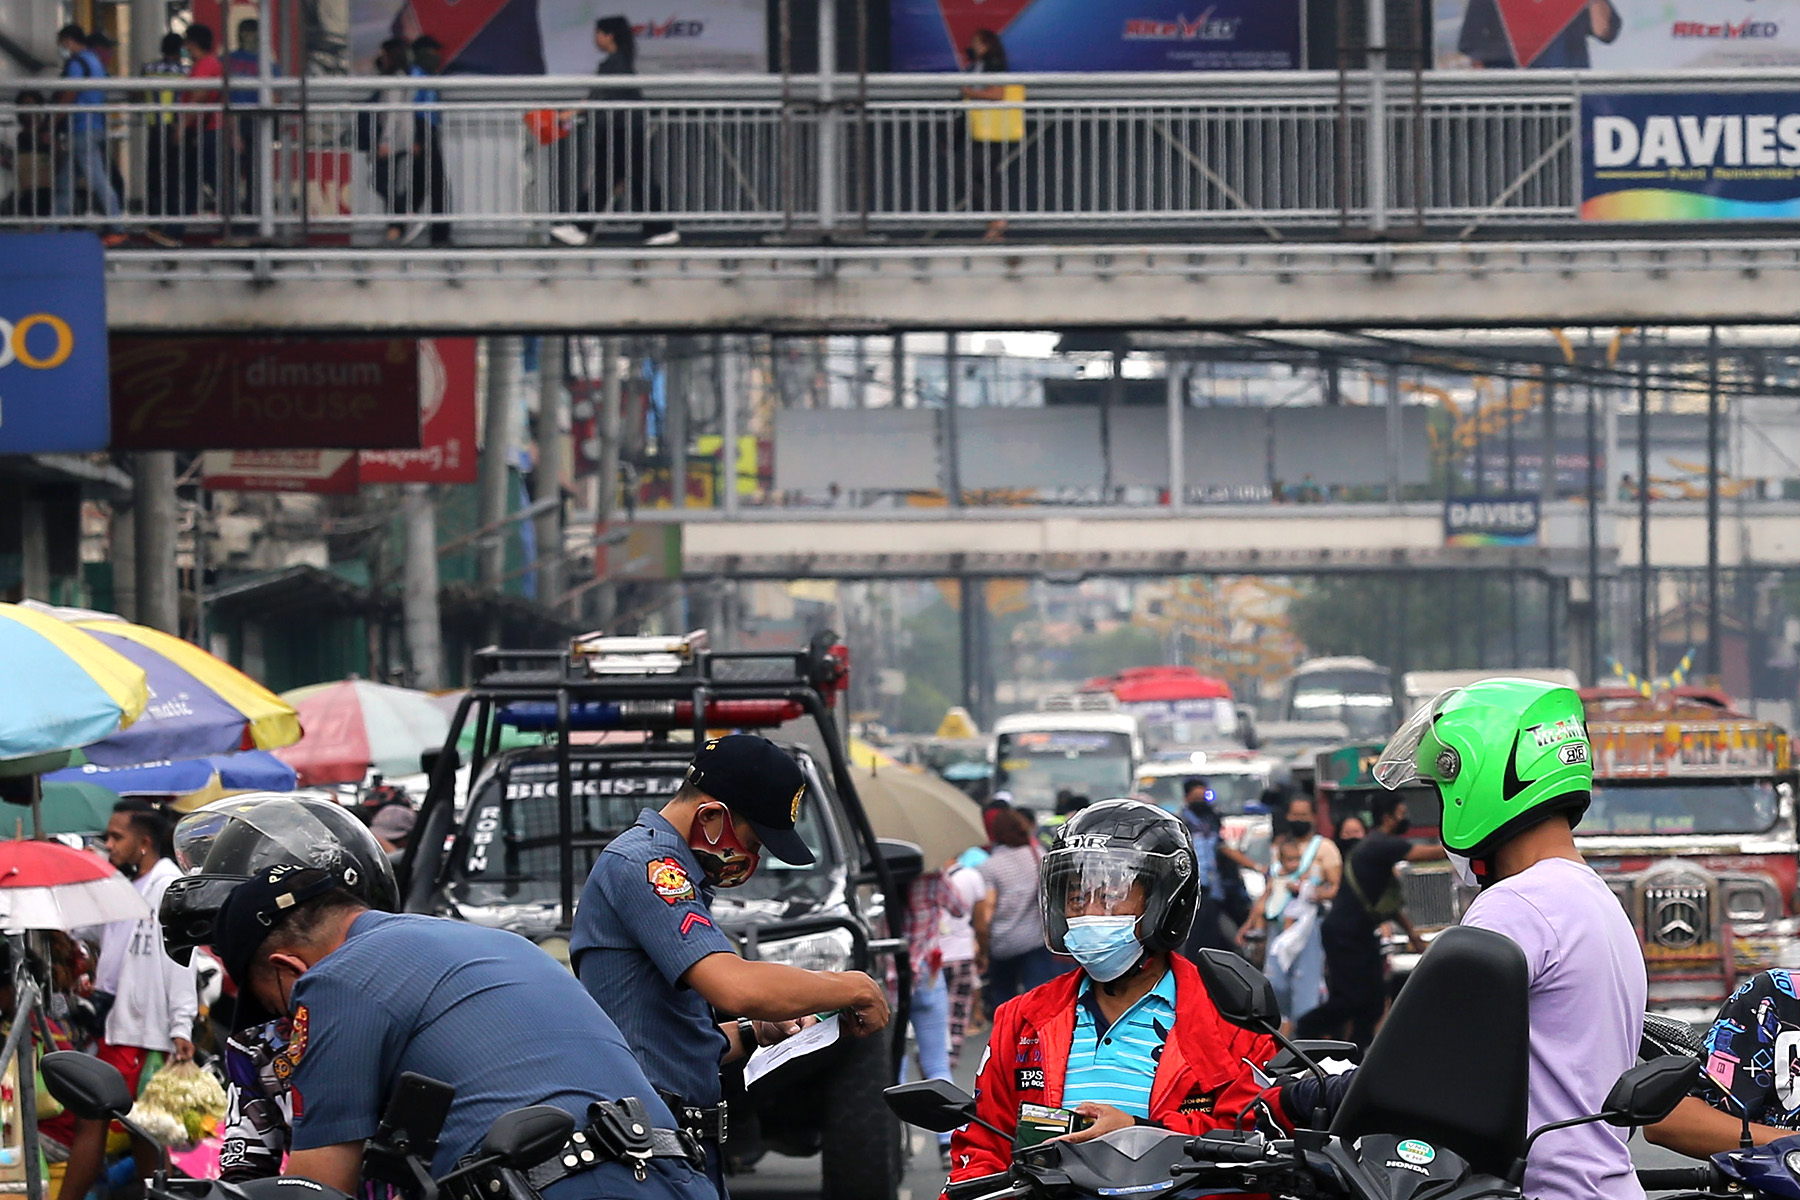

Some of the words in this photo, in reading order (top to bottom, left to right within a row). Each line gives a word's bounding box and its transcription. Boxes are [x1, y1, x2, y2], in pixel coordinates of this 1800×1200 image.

[246, 356, 382, 386] dimsum
[1451, 502, 1535, 527] DAVIES
[468, 806, 500, 872] ROBIN
[1386, 1160, 1430, 1177] HONDA
